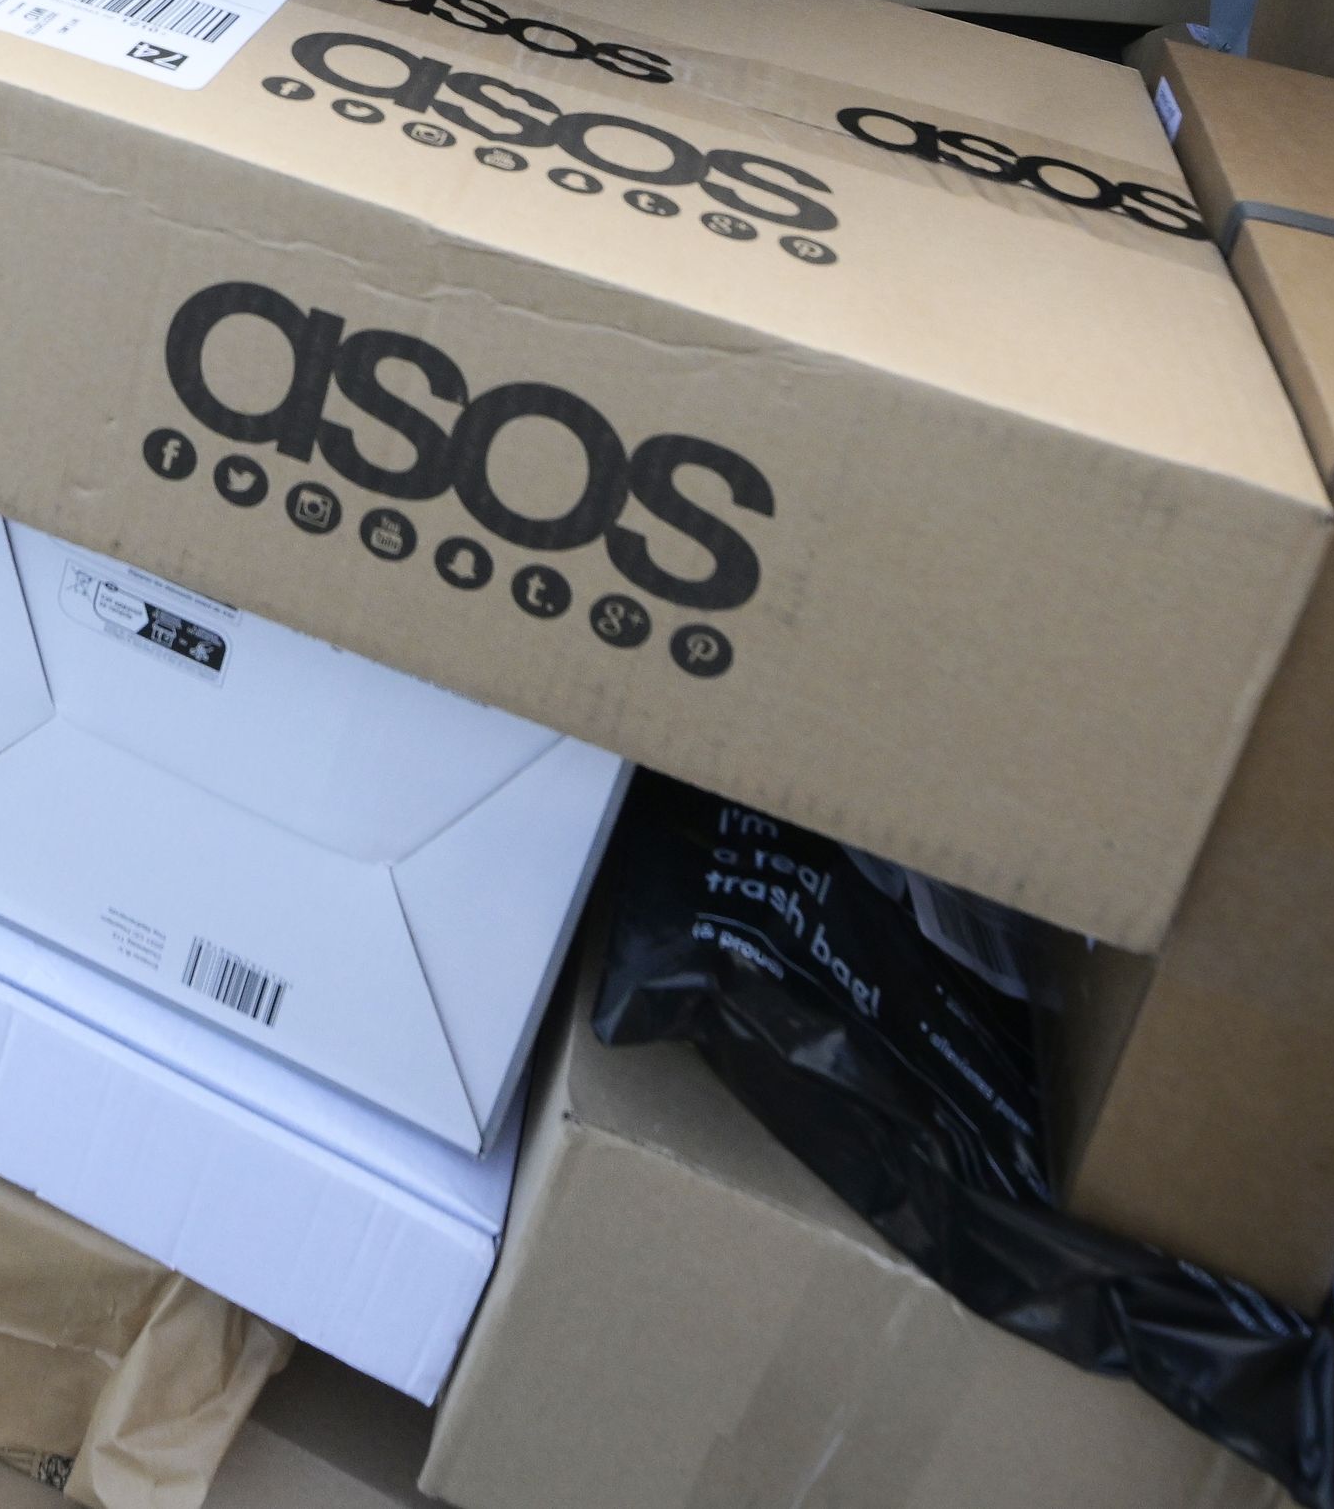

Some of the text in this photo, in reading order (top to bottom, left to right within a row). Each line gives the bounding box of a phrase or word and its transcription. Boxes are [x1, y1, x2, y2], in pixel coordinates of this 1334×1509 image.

[291, 31, 839, 232] asos
[836, 107, 1215, 240] asos
[165, 281, 775, 610] asos
[713, 845, 833, 905] a real
[718, 808, 779, 839] I'm
[704, 869, 882, 1019] trash bag!
